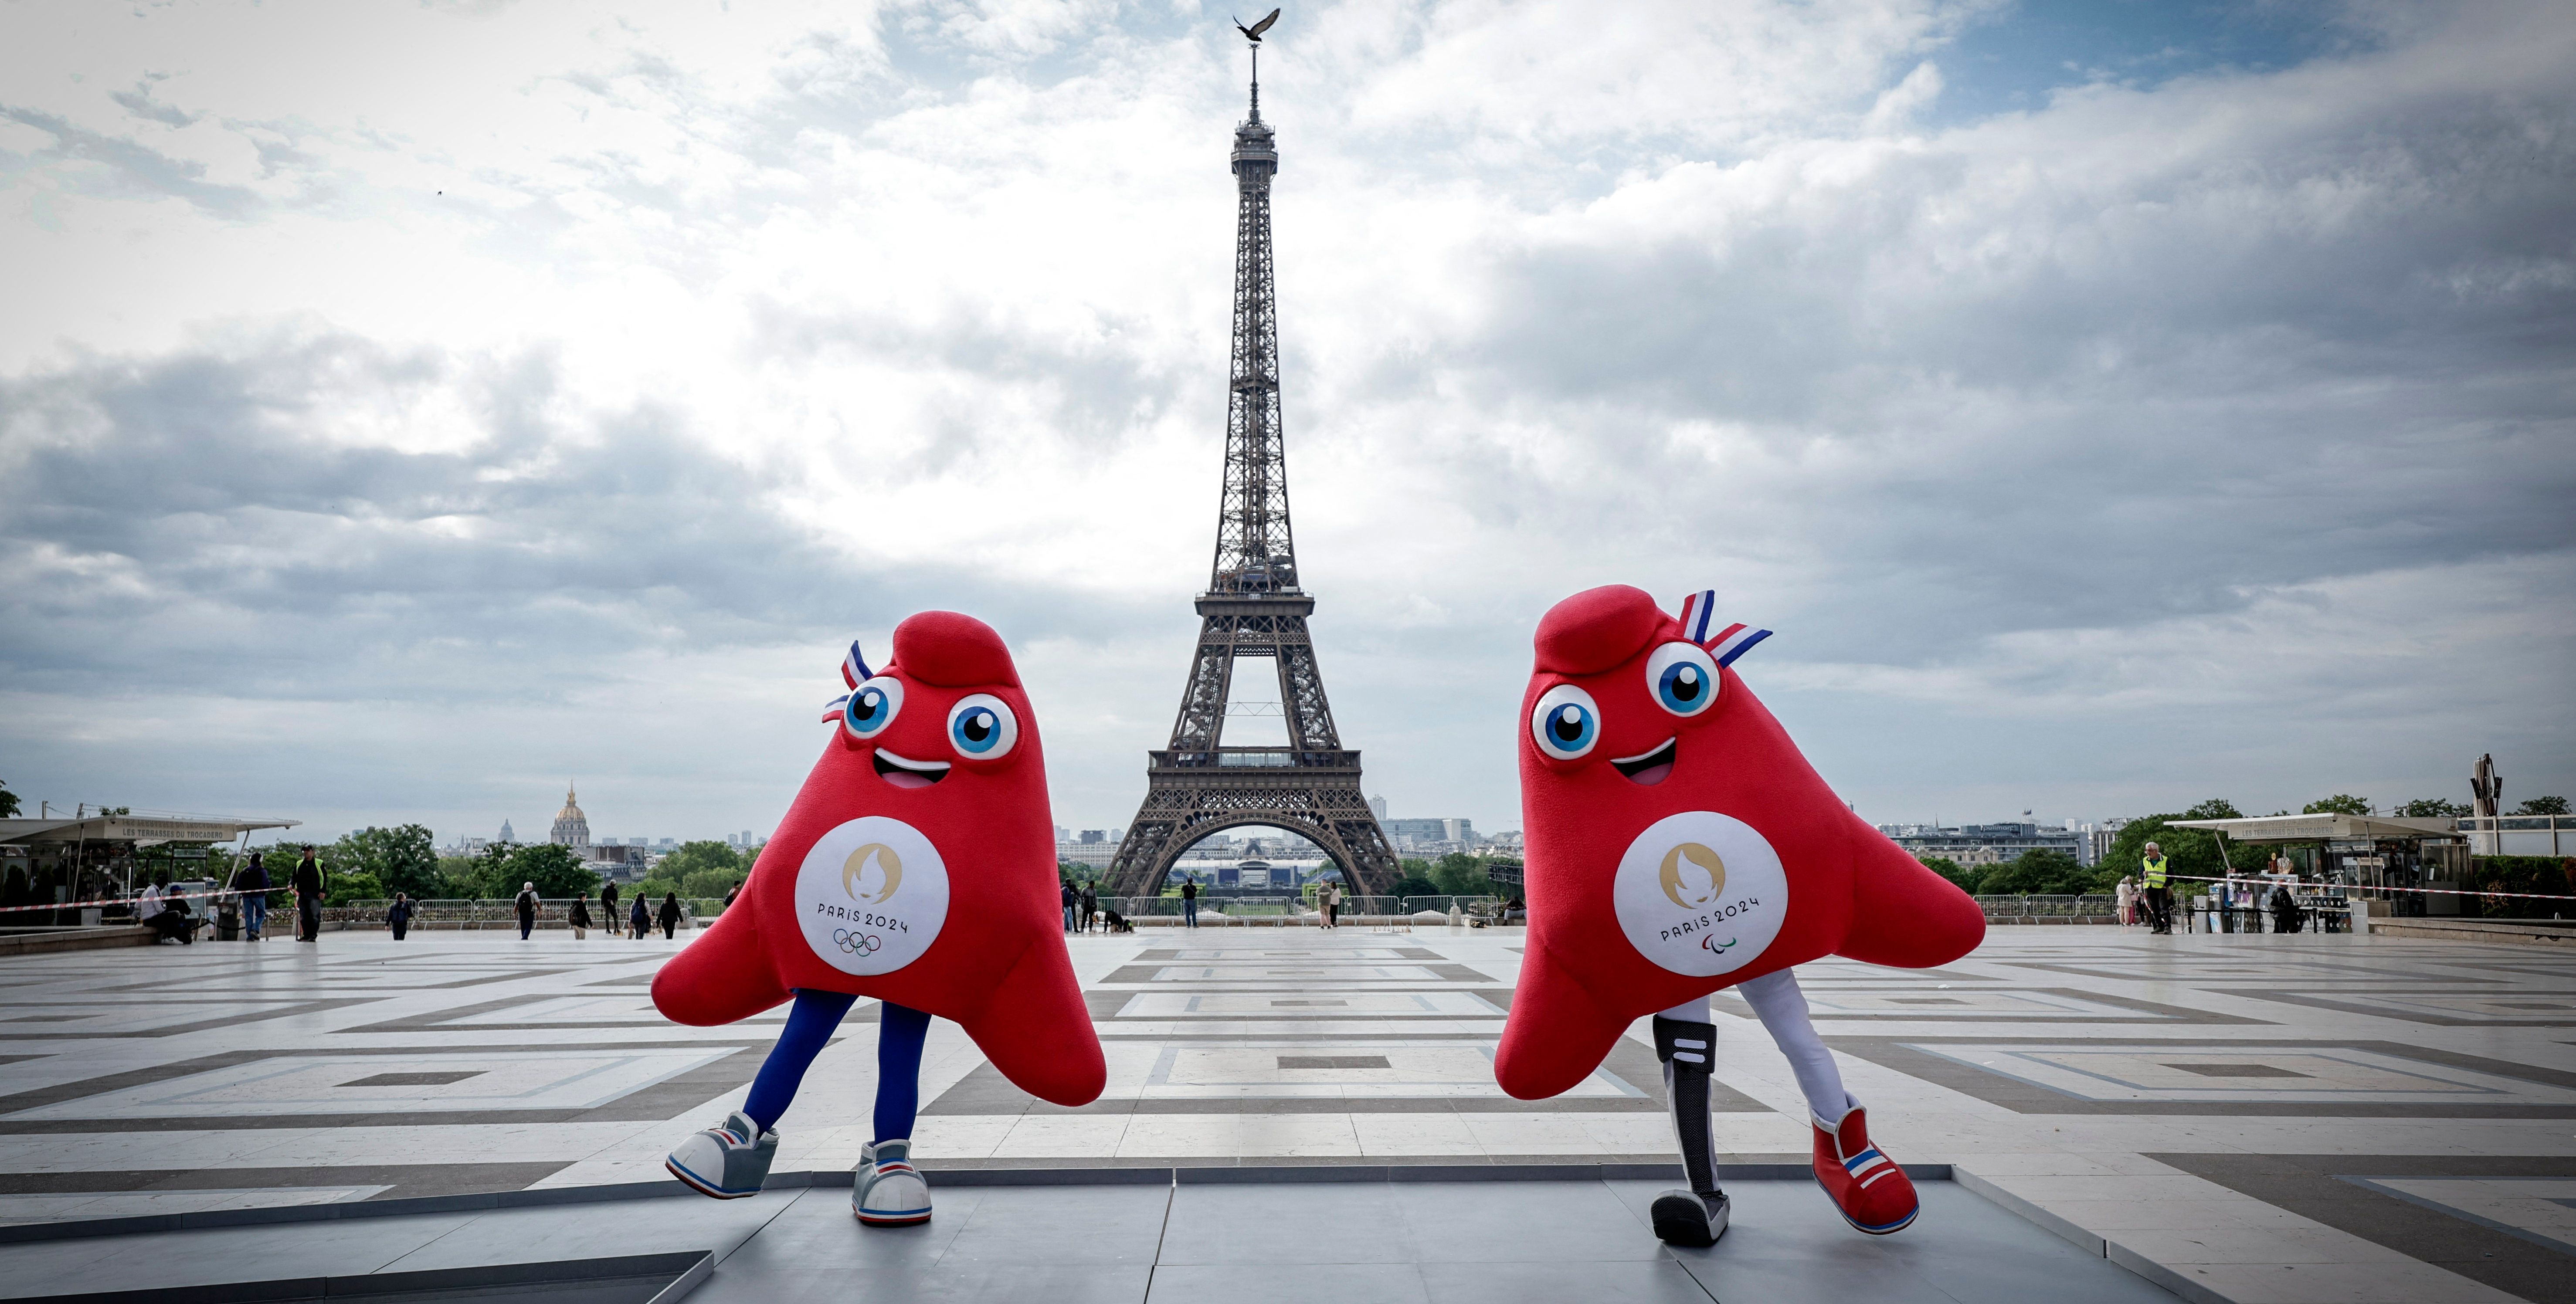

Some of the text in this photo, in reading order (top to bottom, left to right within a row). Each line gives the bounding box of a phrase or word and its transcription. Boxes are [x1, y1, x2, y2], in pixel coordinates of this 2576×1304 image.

[137, 829, 174, 838] TERRASSES
[2297, 826, 2334, 835] TROCADERO
[1714, 898, 1759, 922] 2024
[865, 913, 908, 934] 2024
